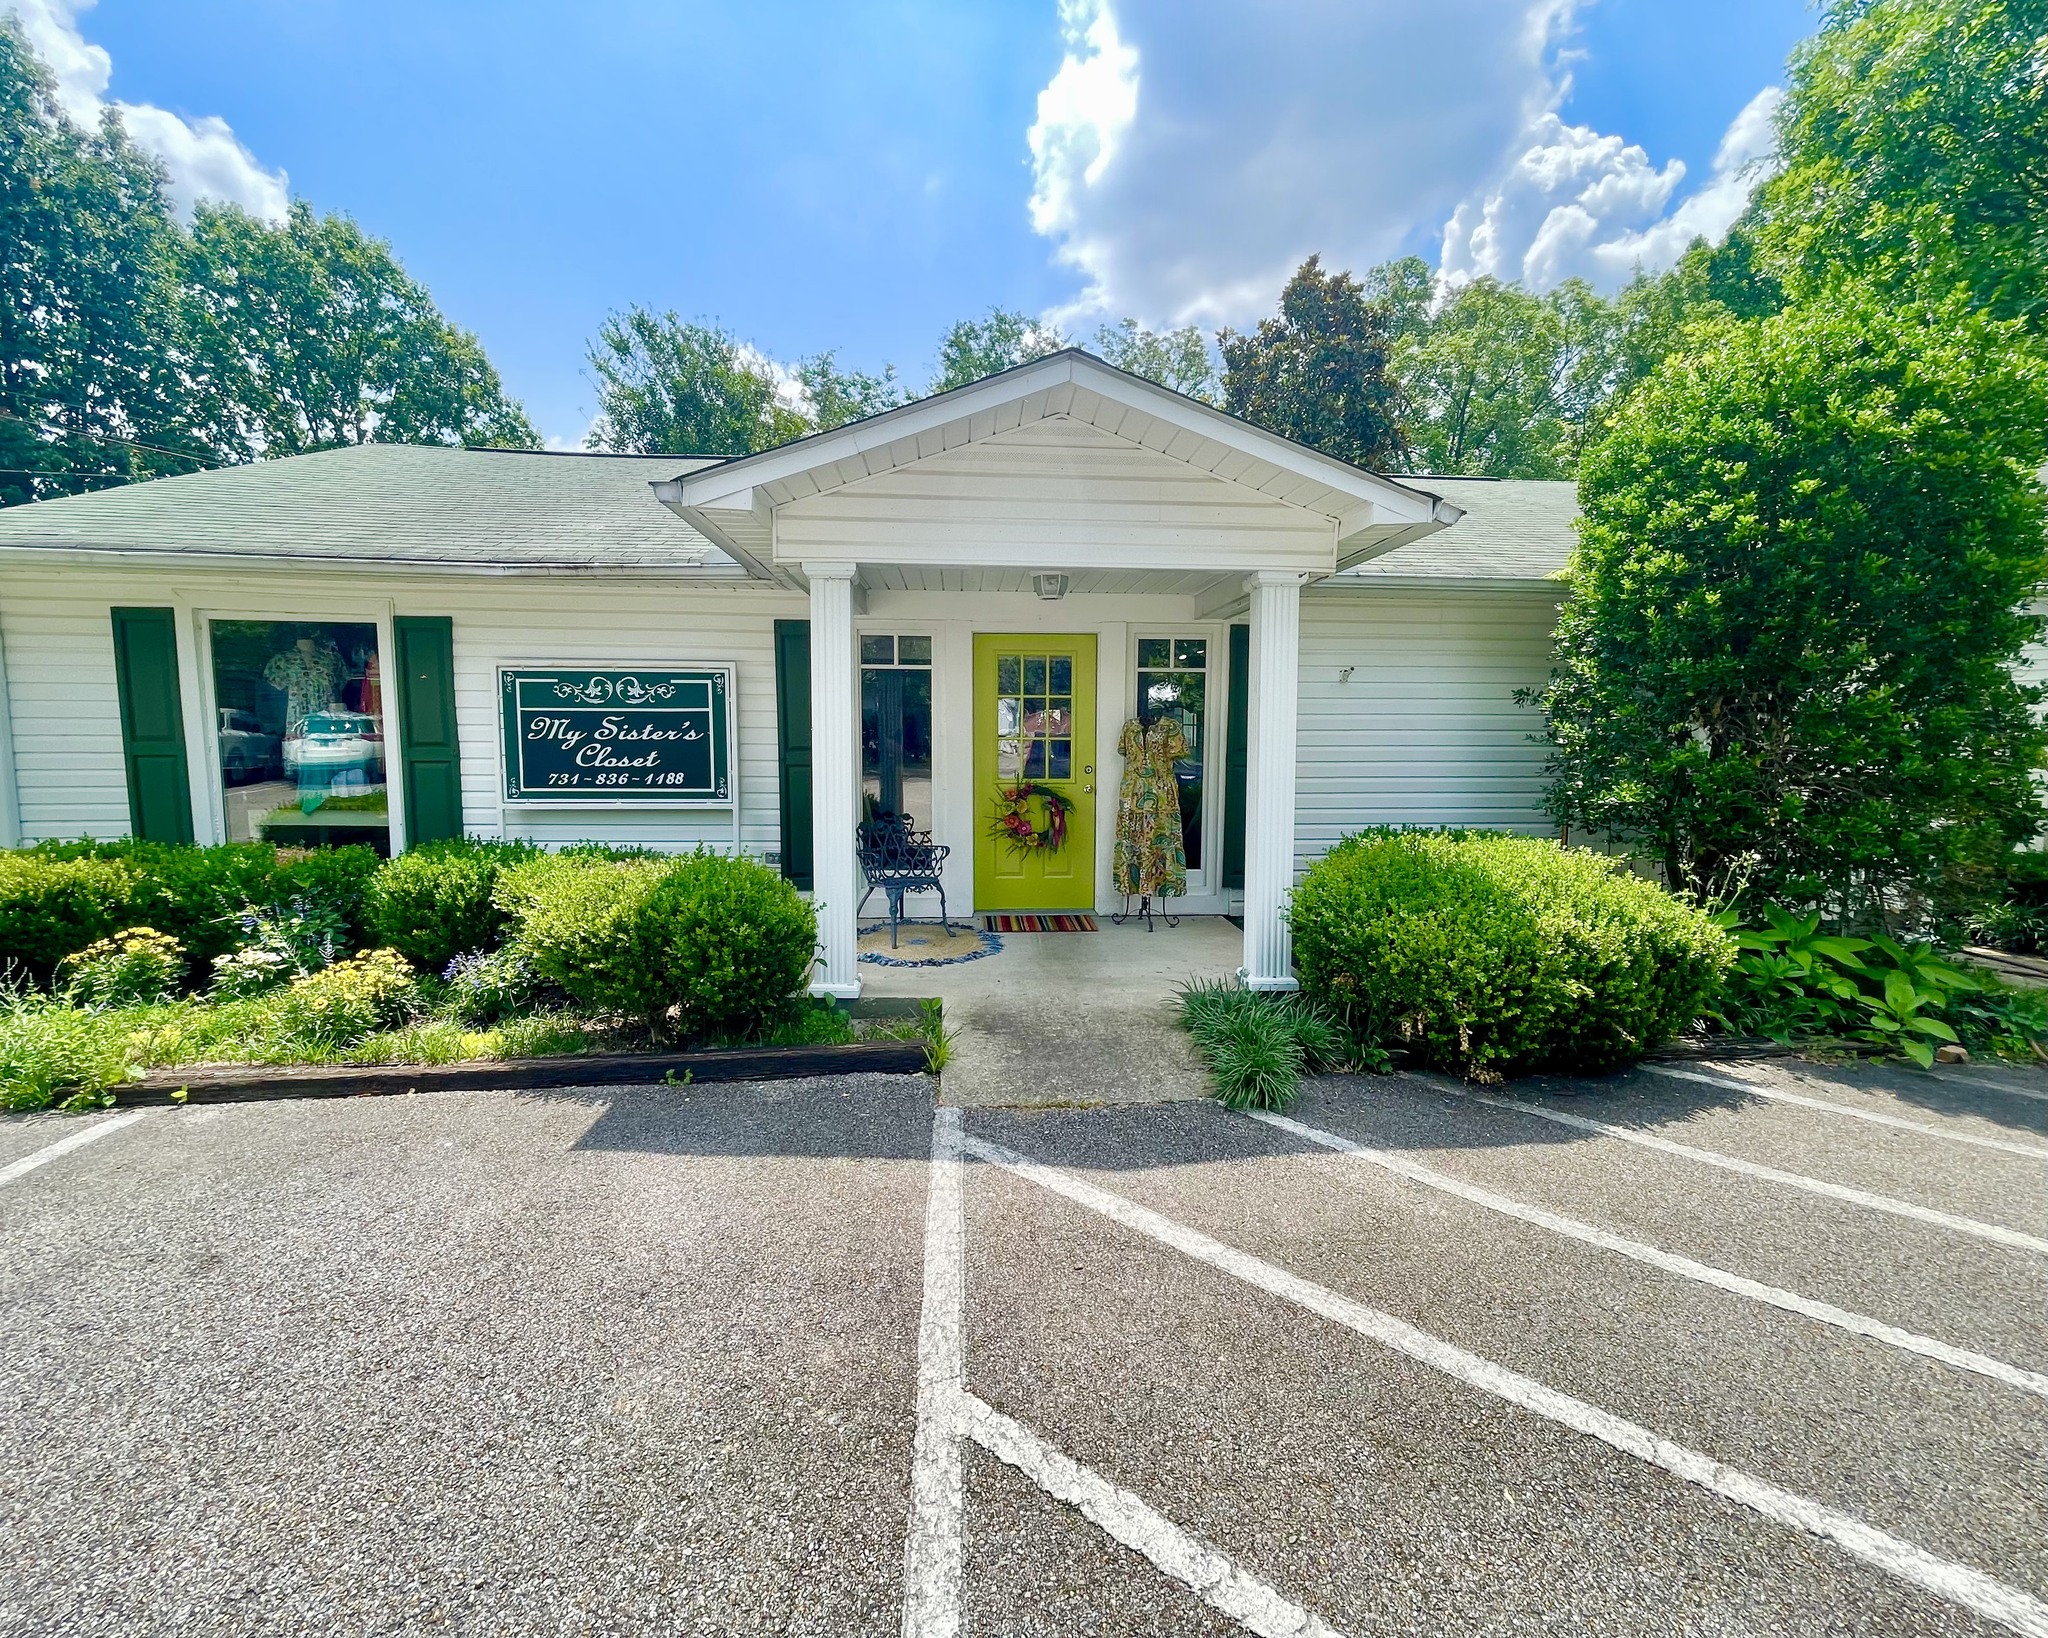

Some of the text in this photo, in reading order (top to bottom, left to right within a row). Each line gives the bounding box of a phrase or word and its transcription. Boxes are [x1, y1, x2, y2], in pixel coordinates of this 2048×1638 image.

[527, 716, 704, 750] My Sister's
[575, 743, 661, 767] Closet
